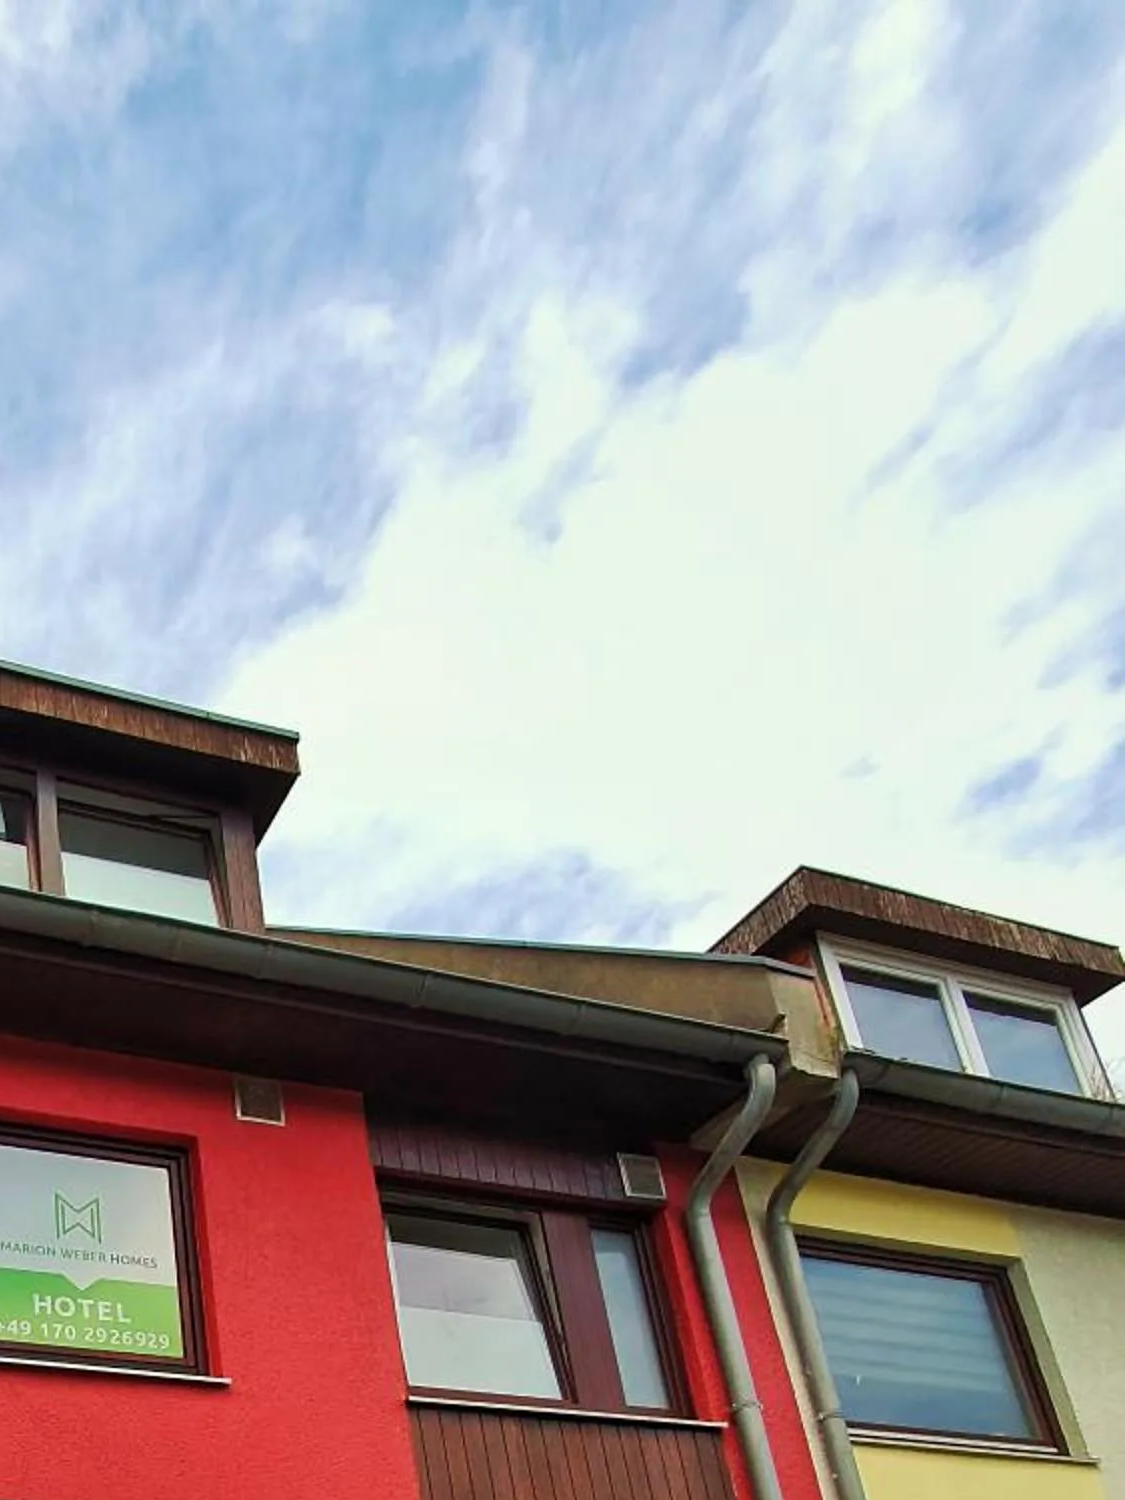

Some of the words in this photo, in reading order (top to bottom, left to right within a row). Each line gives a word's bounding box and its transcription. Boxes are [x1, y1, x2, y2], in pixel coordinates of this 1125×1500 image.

[0, 1241, 56, 1257] MARION
[60, 1248, 106, 1263] WEBER
[110, 1253, 158, 1268] HOMES
[32, 1293, 131, 1323] HOTEL
[40, 1323, 76, 1340] 170
[84, 1327, 170, 1349] 2926929
